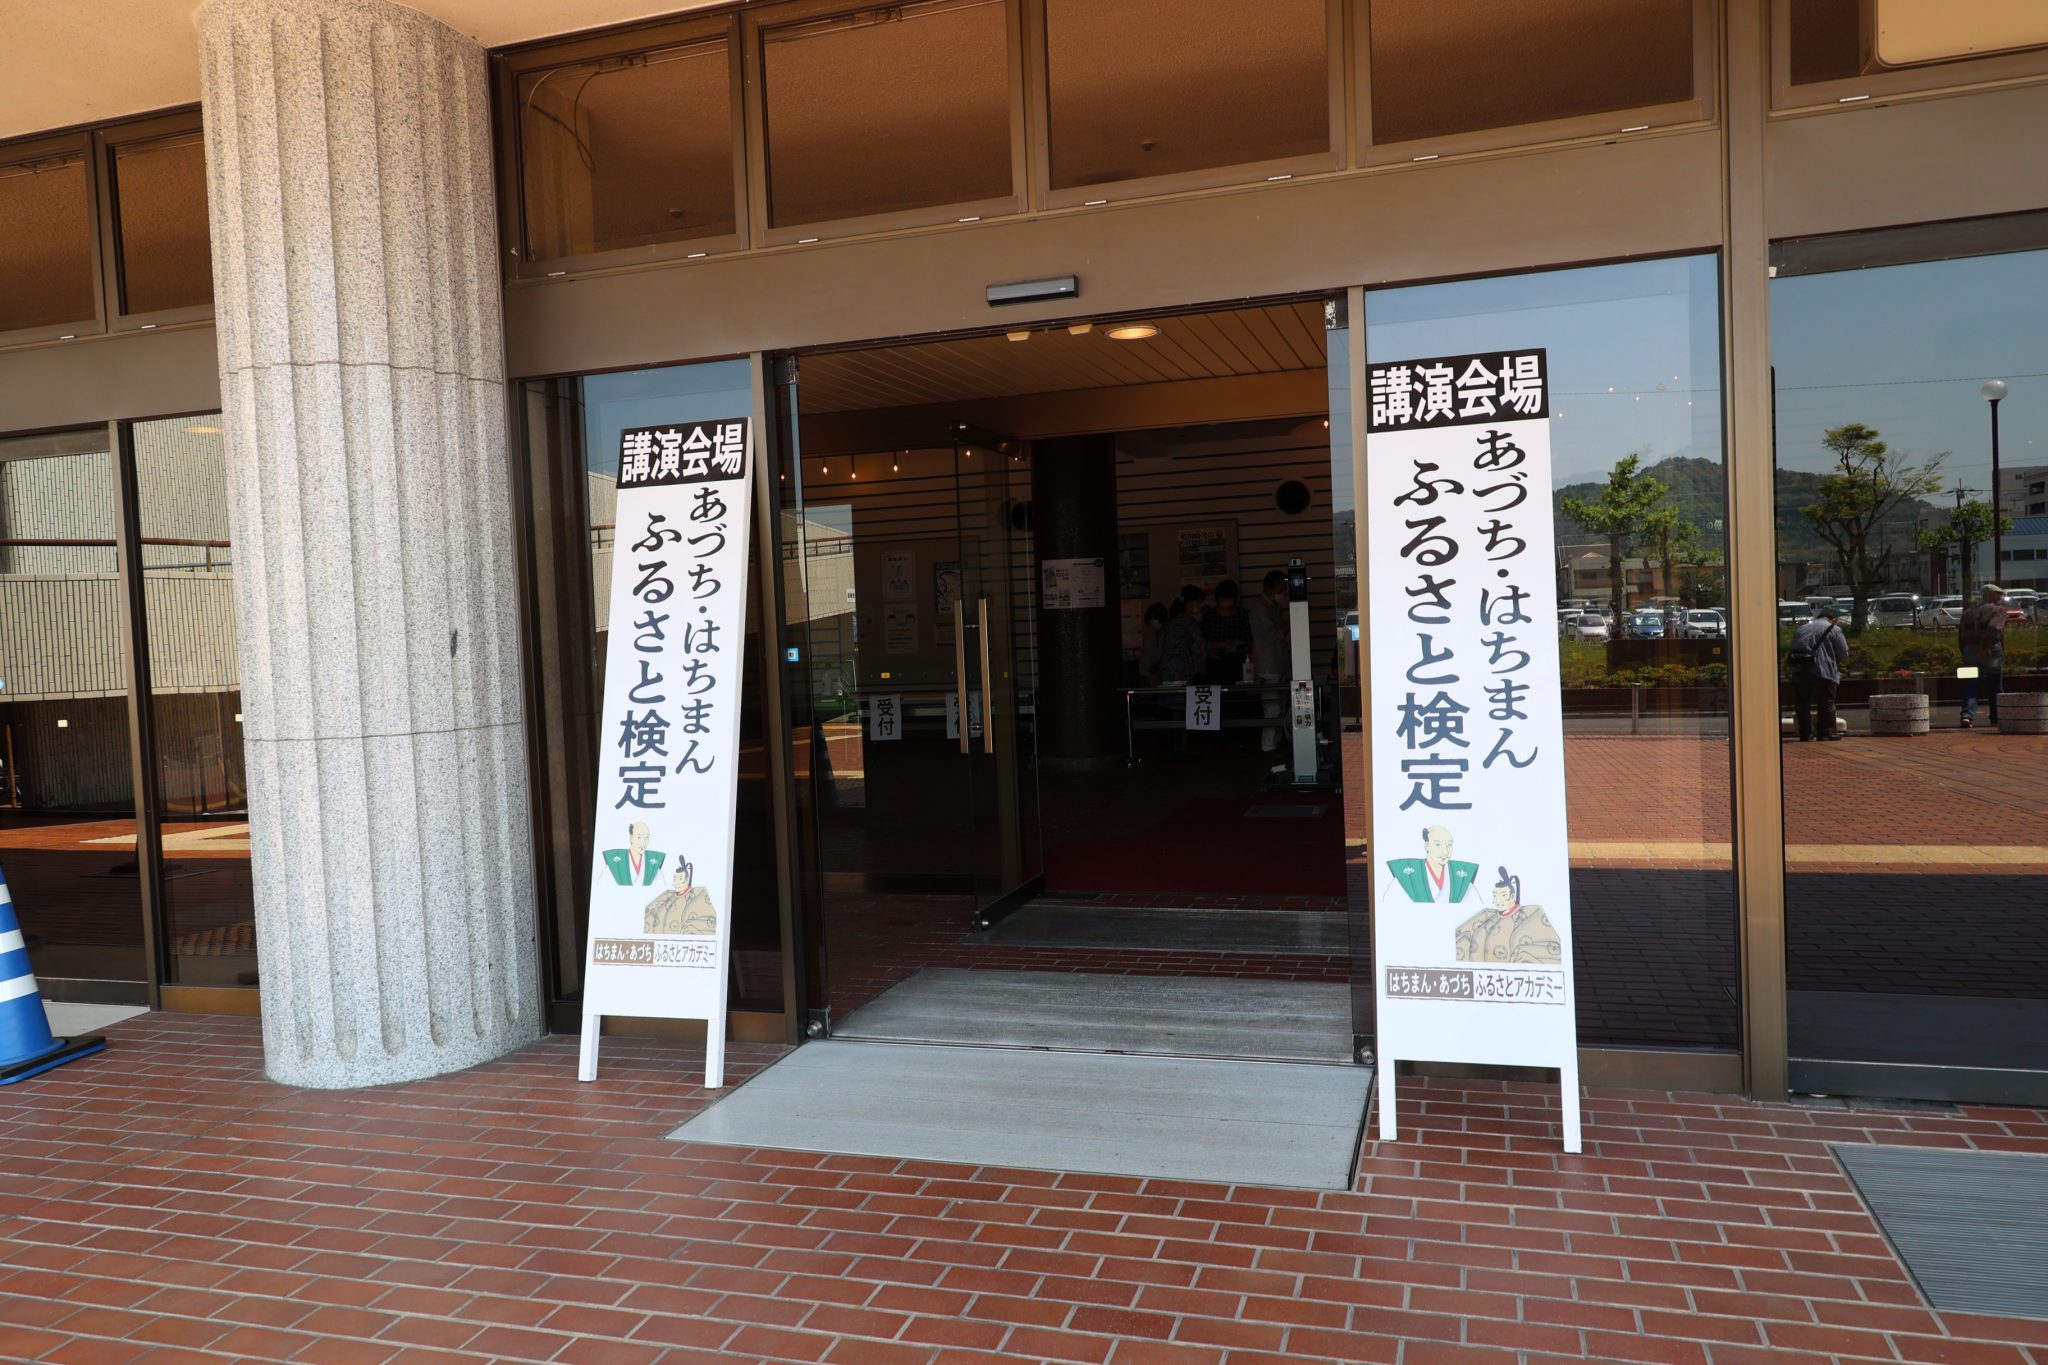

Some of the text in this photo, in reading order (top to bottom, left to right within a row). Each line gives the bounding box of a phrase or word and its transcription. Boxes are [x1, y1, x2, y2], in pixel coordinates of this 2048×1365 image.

[1371, 355, 1543, 428] 講演会場
[622, 424, 744, 484] 講演会場
[676, 486, 728, 775] あづち・はちまん
[1472, 428, 1538, 769] あづち・はちまん
[615, 512, 683, 810] ふるさと検定
[1394, 459, 1473, 811] ふるさと検定
[877, 697, 895, 736] 受付
[1193, 686, 1213, 726] 受付
[595, 943, 715, 963] はちまん・あづち ふるさとアカデミー
[1389, 972, 1563, 999] はちまん・あづち ふるさとアカデミー
